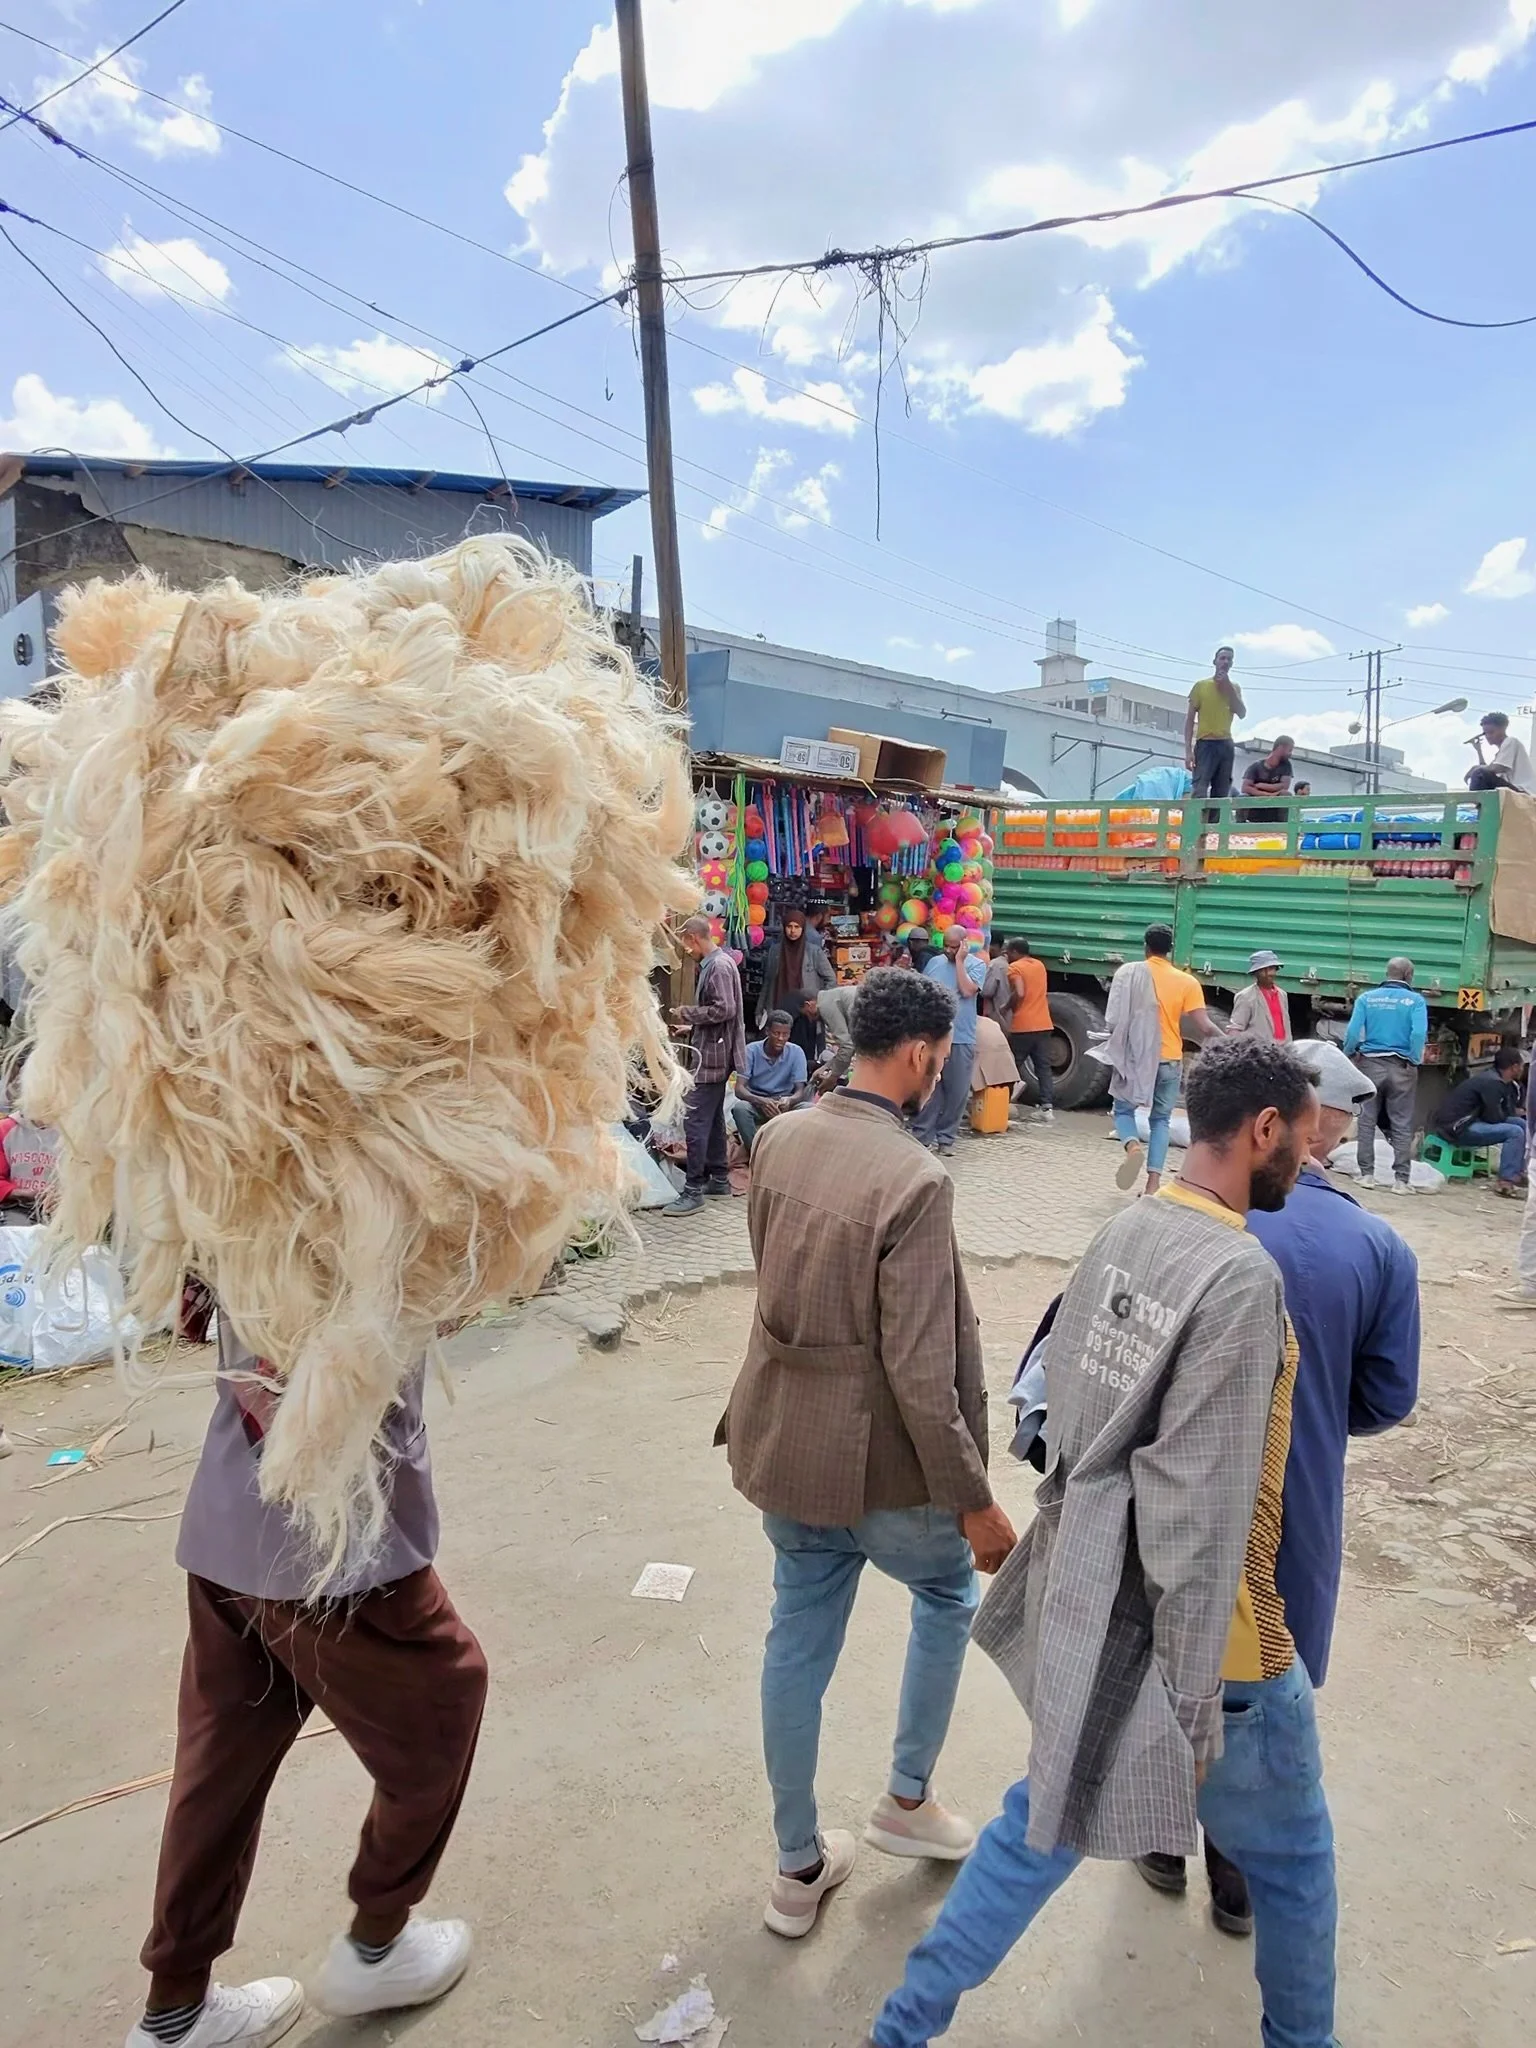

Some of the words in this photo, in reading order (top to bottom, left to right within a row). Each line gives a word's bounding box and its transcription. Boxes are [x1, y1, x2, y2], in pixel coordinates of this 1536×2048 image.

[10, 1152, 57, 1165] WISCON
[32, 1166, 44, 1176] W
[1092, 1314, 1129, 1346] Gallery
